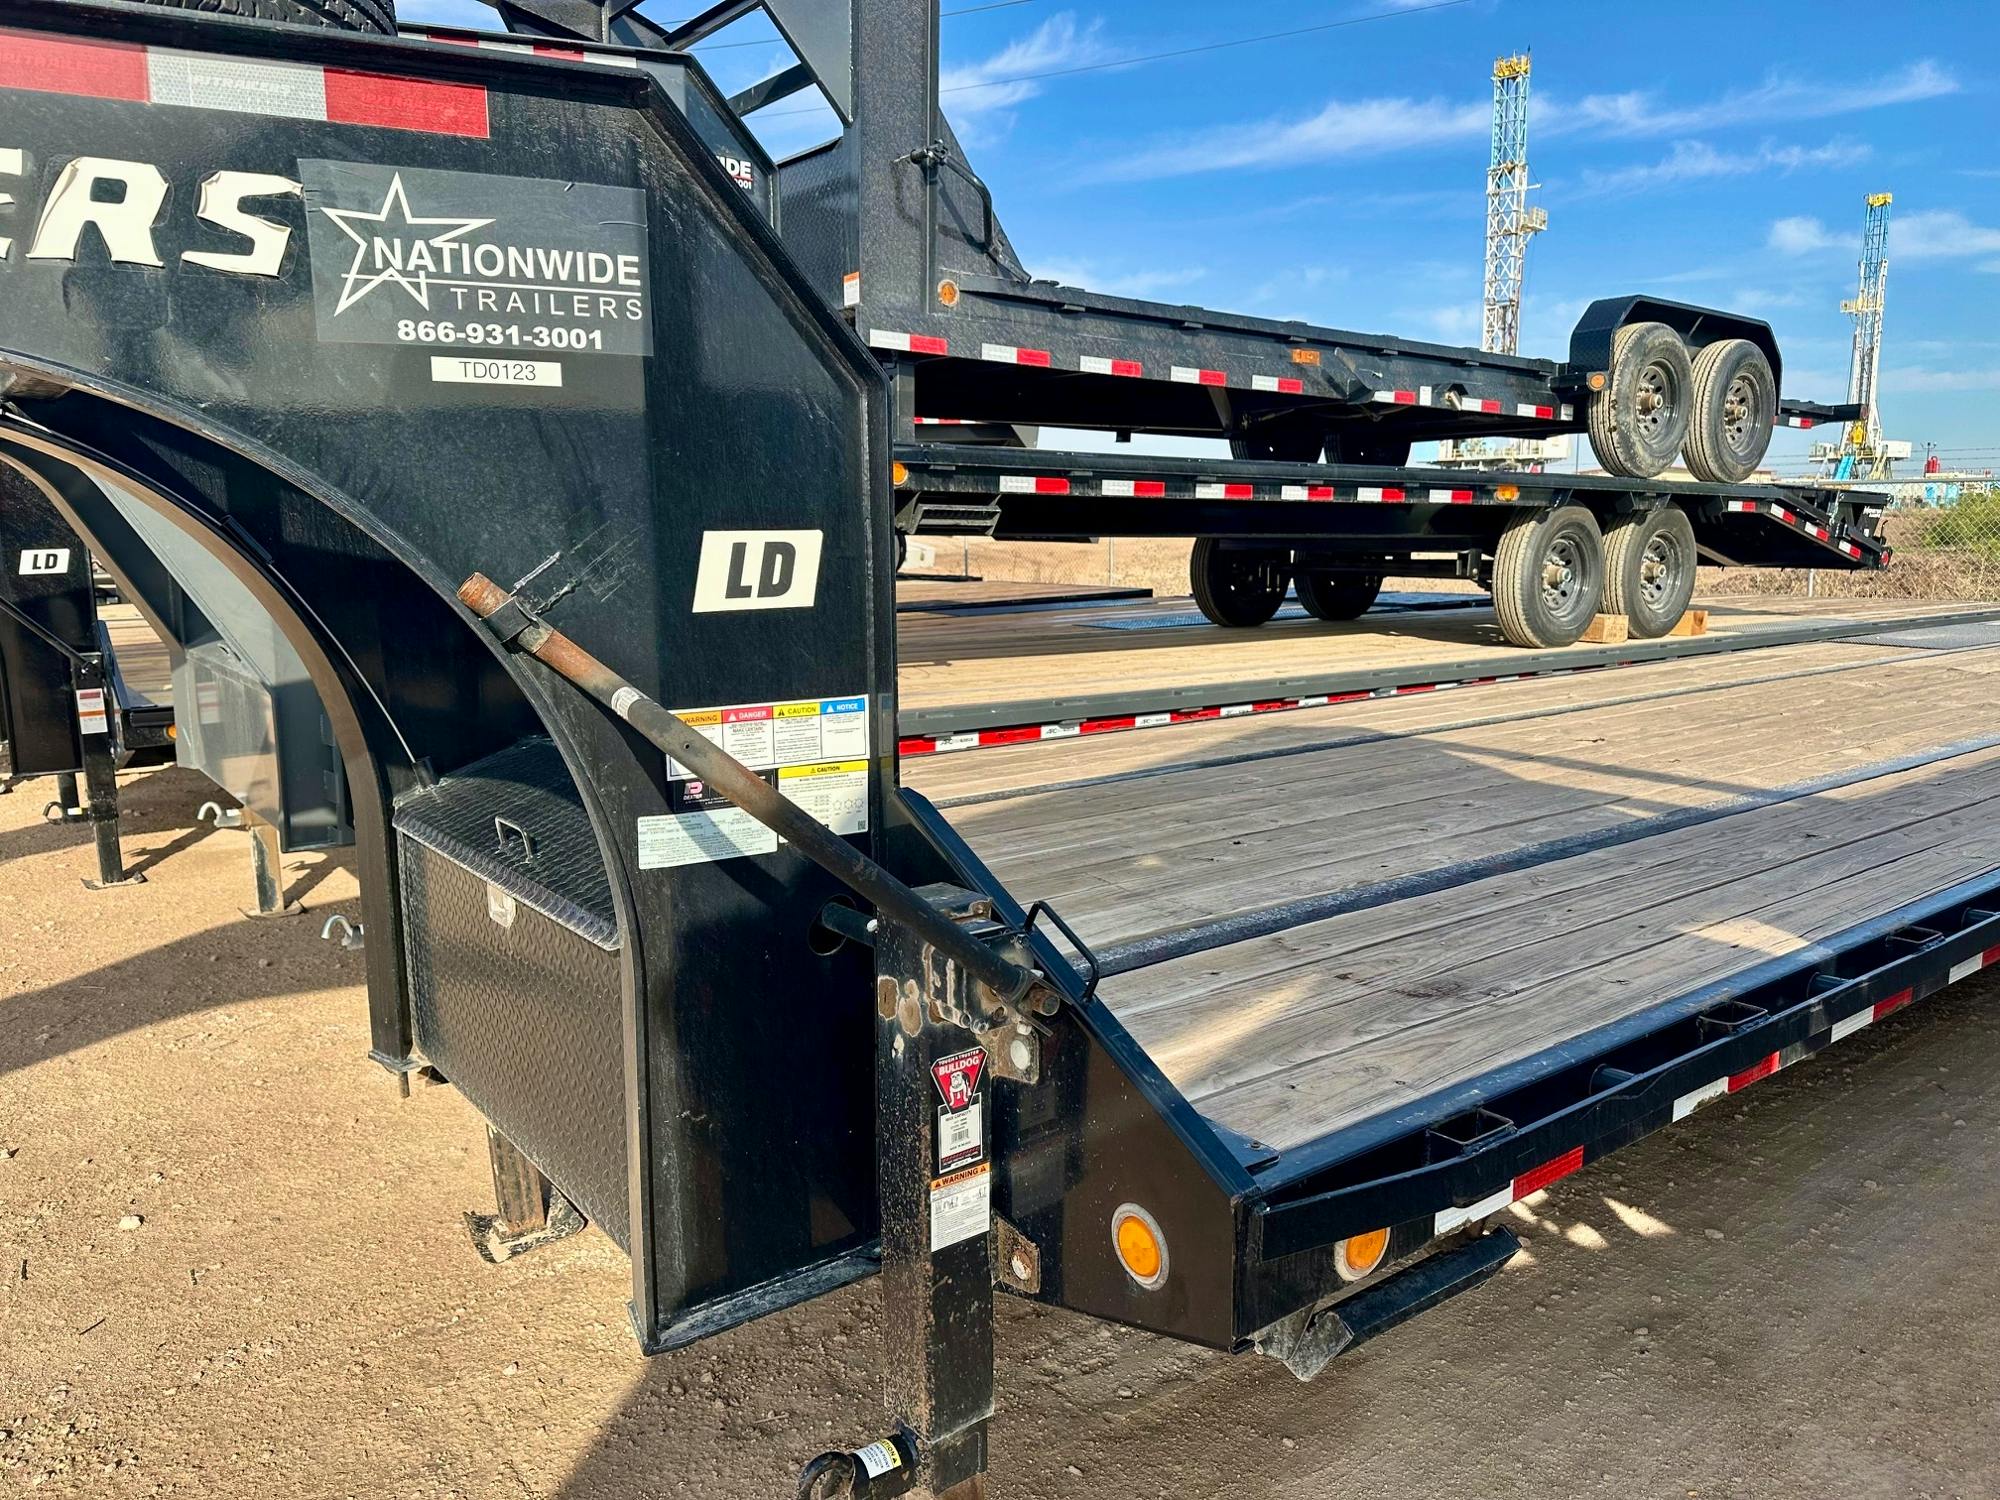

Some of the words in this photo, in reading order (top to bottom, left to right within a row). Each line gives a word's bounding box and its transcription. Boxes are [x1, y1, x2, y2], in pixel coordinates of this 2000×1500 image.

[734, 178, 752, 190] 001
[0, 147, 303, 278] RS
[373, 236, 642, 287] NATIONWIDE
[450, 287, 643, 321] TRAILERS
[397, 319, 602, 350] 866-931-3001
[458, 361, 537, 382] TD0123
[31, 553, 59, 571] LD
[725, 541, 797, 600] LD
[738, 710, 768, 720] DANGER
[787, 706, 817, 715] CAUTION
[836, 702, 859, 711] NOTICE
[816, 765, 841, 773] CAUTION
[938, 1055, 980, 1077] BULLDOG
[941, 1166, 979, 1186] WARNING
